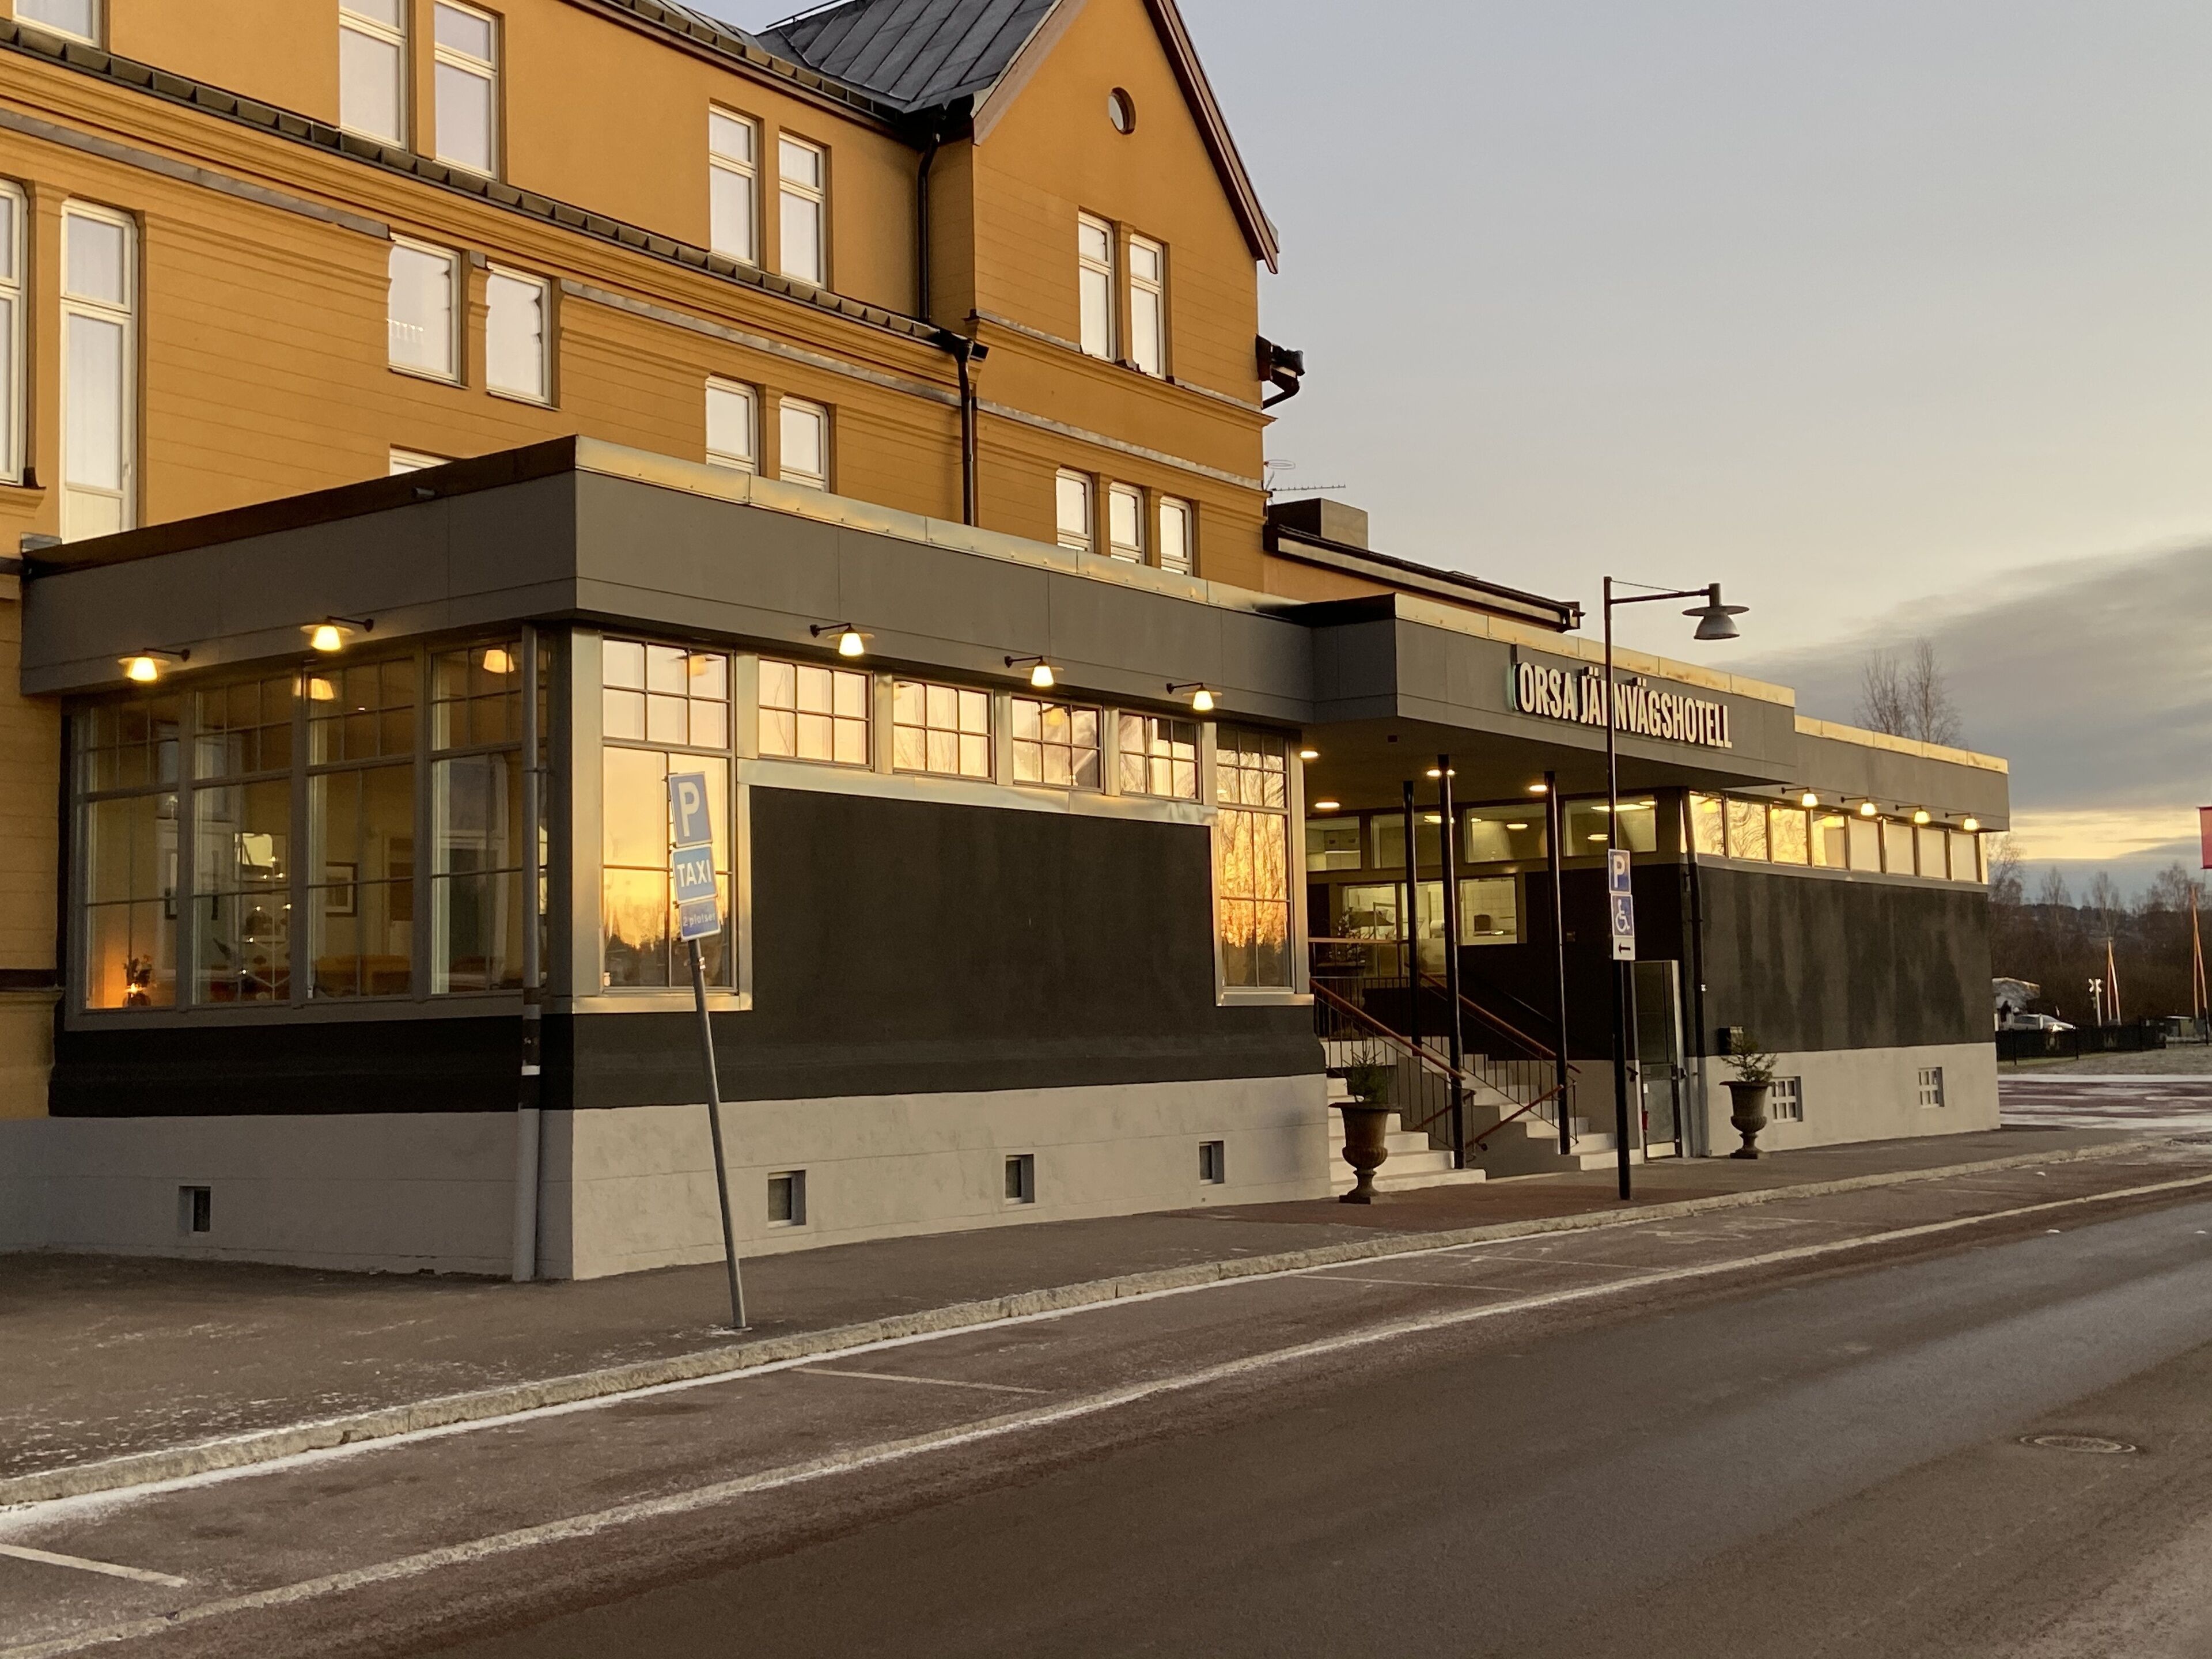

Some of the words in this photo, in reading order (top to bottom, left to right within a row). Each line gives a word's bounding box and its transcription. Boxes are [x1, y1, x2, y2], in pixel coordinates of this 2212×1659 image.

[1519, 661, 1577, 721] ORSA
[678, 781, 700, 838] P
[677, 859, 712, 888] TAXI
[1613, 854, 1626, 888] P
[683, 916, 688, 927] 2
